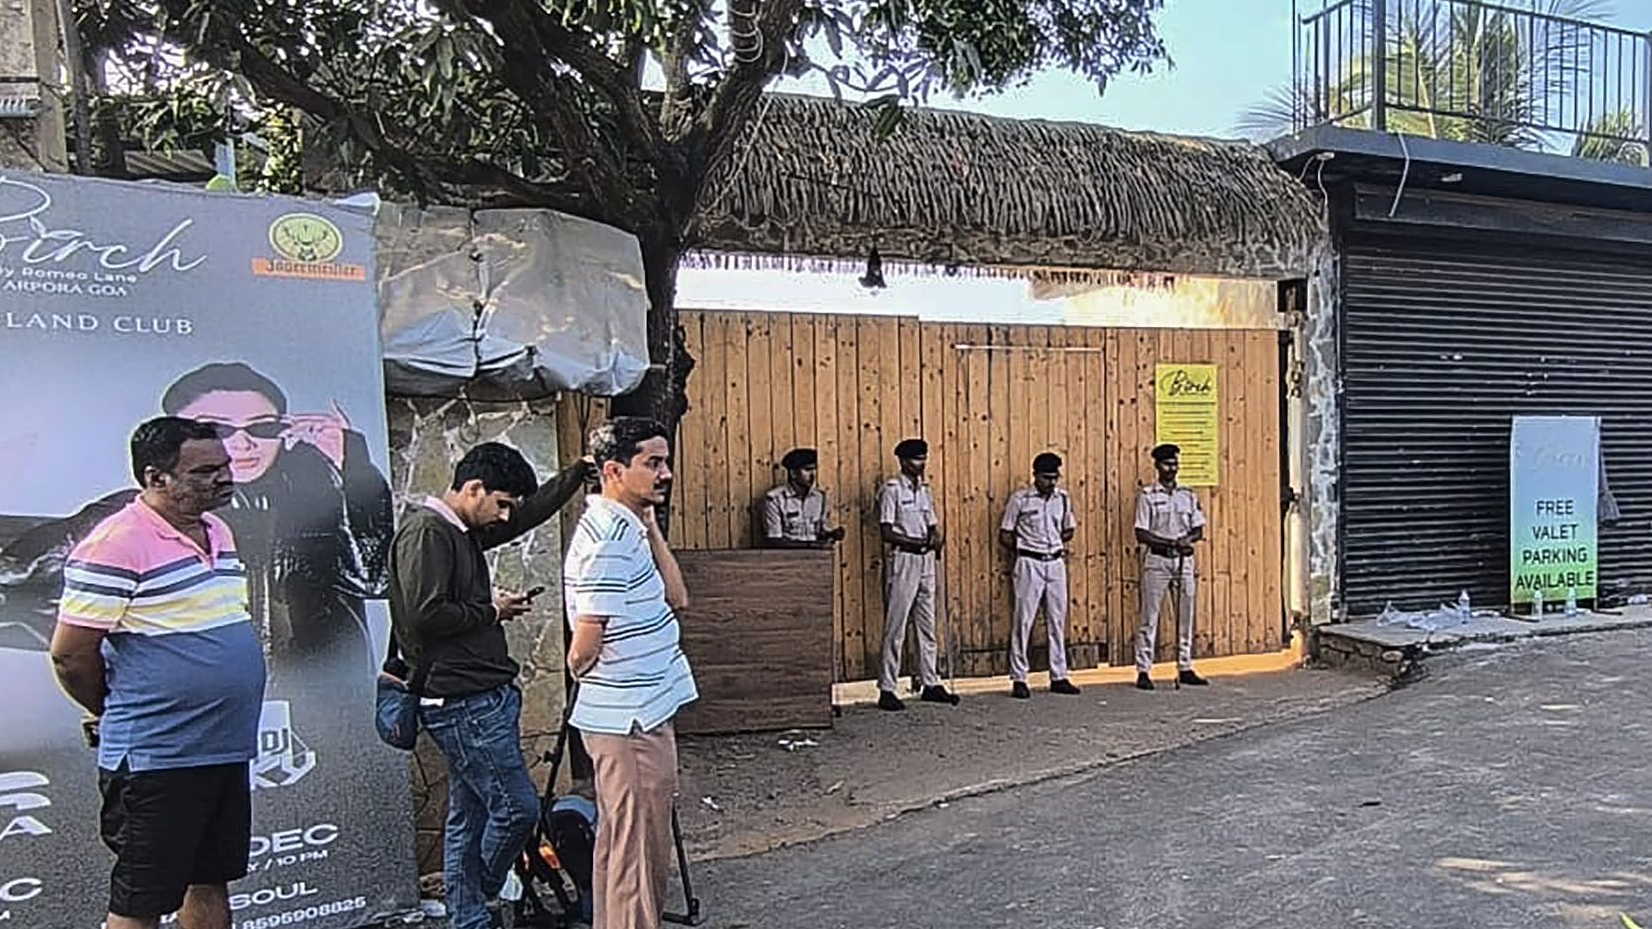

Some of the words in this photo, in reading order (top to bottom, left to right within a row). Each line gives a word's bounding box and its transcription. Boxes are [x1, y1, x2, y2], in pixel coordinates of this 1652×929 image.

[22, 266, 88, 281] Romeo
[94, 271, 138, 284] Lane
[88, 284, 128, 297] GOA
[114, 316, 193, 334] CLUB
[1536, 500, 1574, 516] FREE
[1532, 524, 1579, 540] VALET
[1522, 547, 1588, 564] PARKING
[1515, 571, 1595, 591] AVAILABLE
